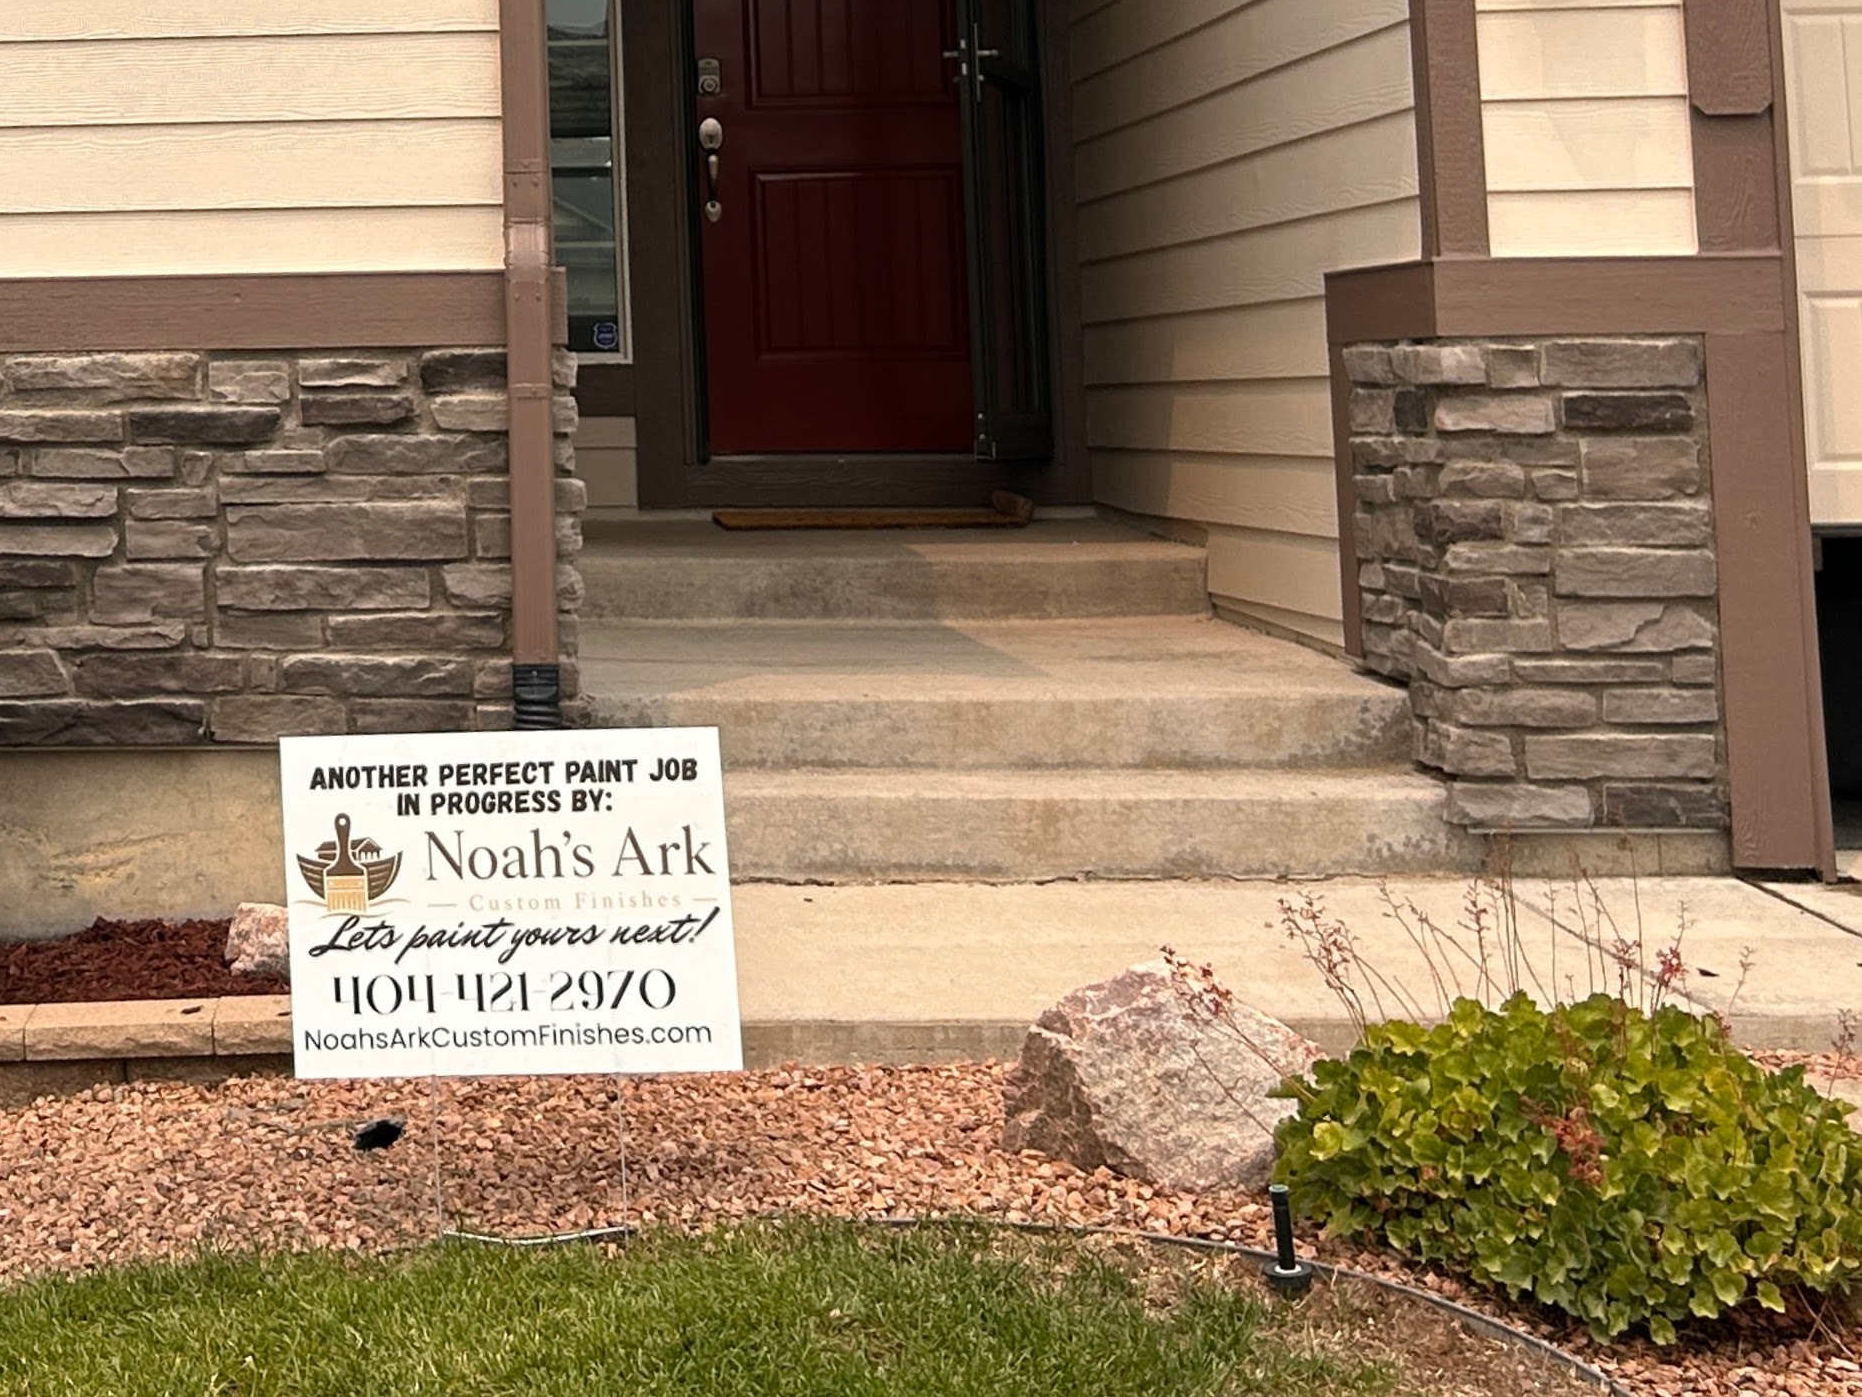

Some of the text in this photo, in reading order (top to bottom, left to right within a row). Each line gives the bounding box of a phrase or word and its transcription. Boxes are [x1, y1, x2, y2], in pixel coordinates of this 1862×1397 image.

[309, 757, 698, 790] ANOTHER PERFECT PAINT JOB
[397, 789, 613, 816] IN PROGRESS BY:
[424, 824, 716, 882] Noah's Ark
[469, 891, 682, 912] Custom Finishes
[308, 906, 721, 965] Lets paint yours next!
[332, 968, 677, 1016] 404-421-2970
[304, 1023, 712, 1052] NoahsArkCustomFinishes.com
